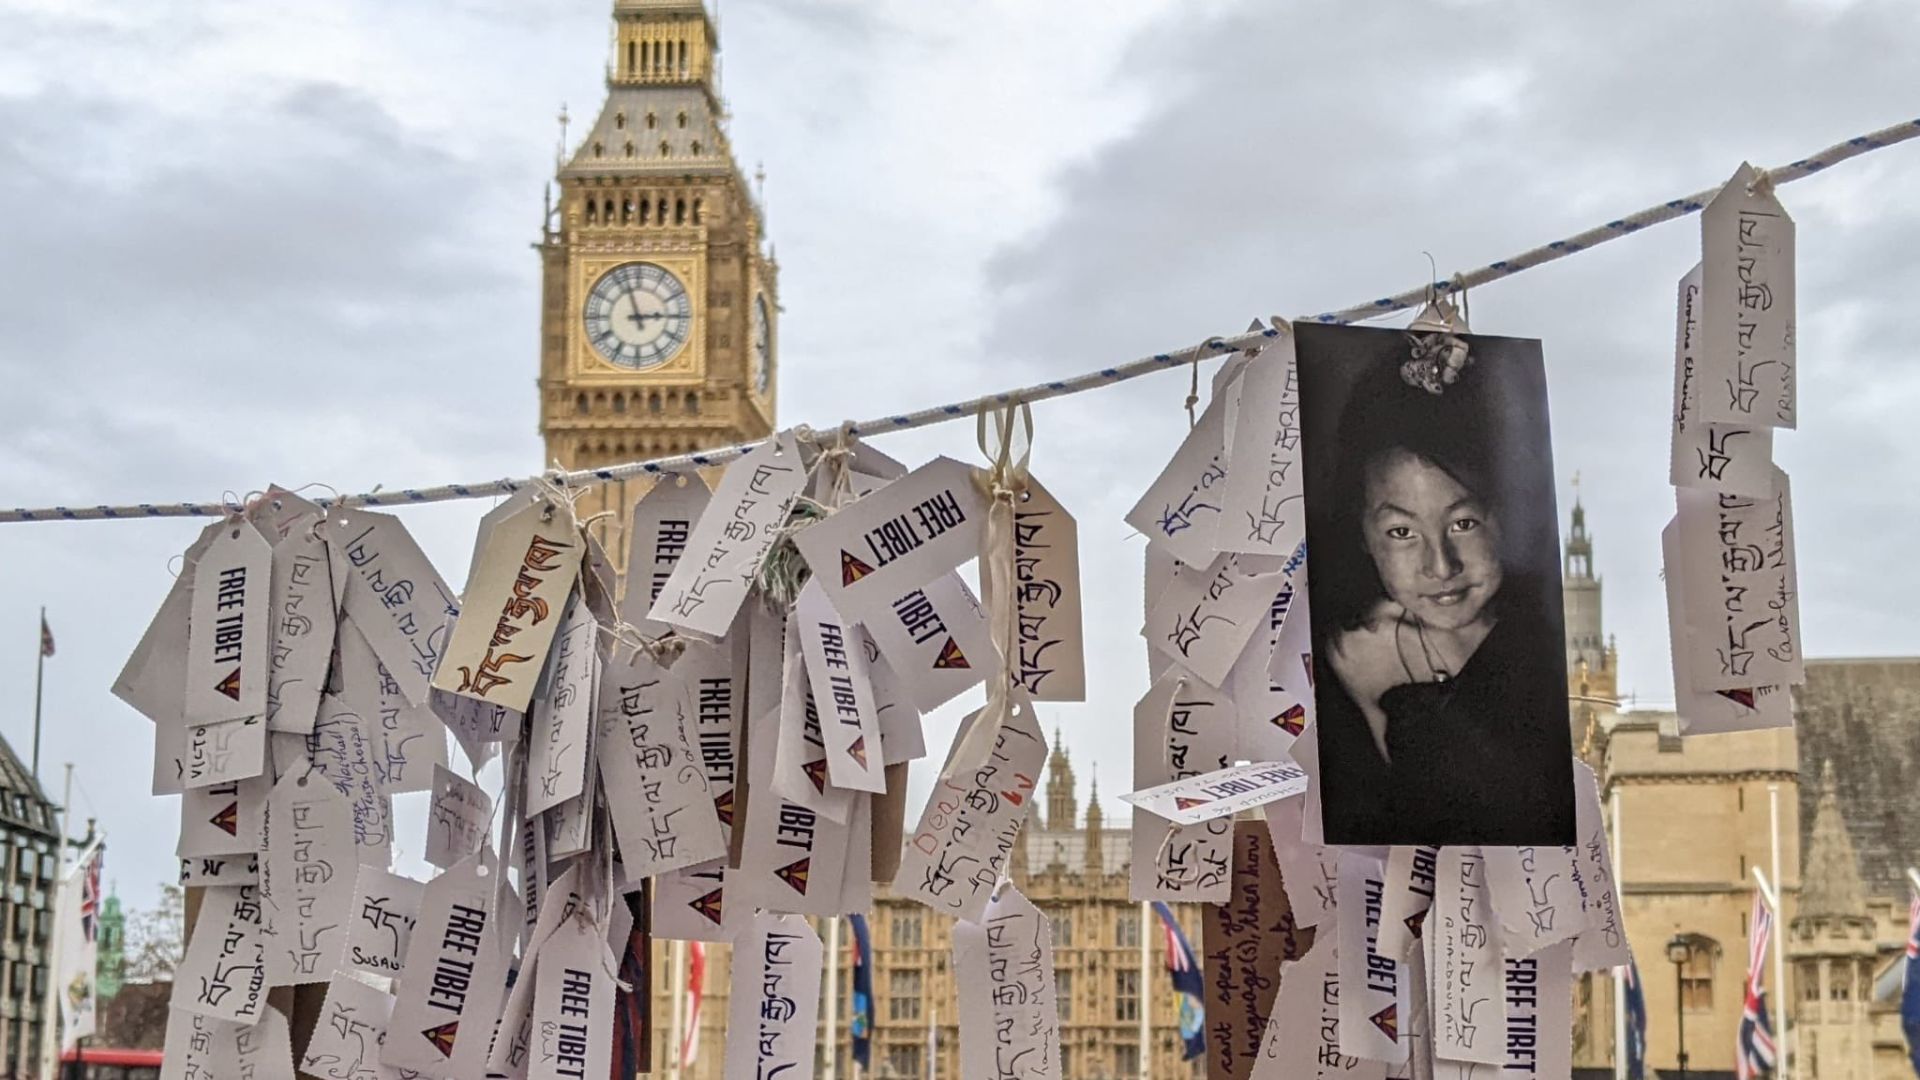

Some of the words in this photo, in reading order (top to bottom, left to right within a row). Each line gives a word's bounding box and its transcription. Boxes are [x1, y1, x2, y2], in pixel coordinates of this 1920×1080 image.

[912, 489, 966, 539] FREE
[864, 514, 924, 568] TIBET
[217, 567, 246, 612] FREE
[215, 612, 246, 664] TIBET
[818, 622, 848, 671] FREE
[700, 678, 731, 724] FREE
[830, 675, 862, 730] TIBET
[700, 732, 734, 784] TIBET
[1252, 767, 1304, 785] FREE
[1200, 778, 1266, 800] TIBET
[776, 798, 816, 852] IBET
[442, 904, 486, 955] FREE
[1218, 902, 1240, 937] yo
[1238, 884, 1260, 931] then
[428, 957, 474, 1016] TIBET
[560, 968, 591, 1018] FREE
[1208, 949, 1239, 1005] speak
[1505, 958, 1537, 1010] FREE
[556, 1024, 587, 1080] TIBET
[1506, 1015, 1538, 1073] TIBET
